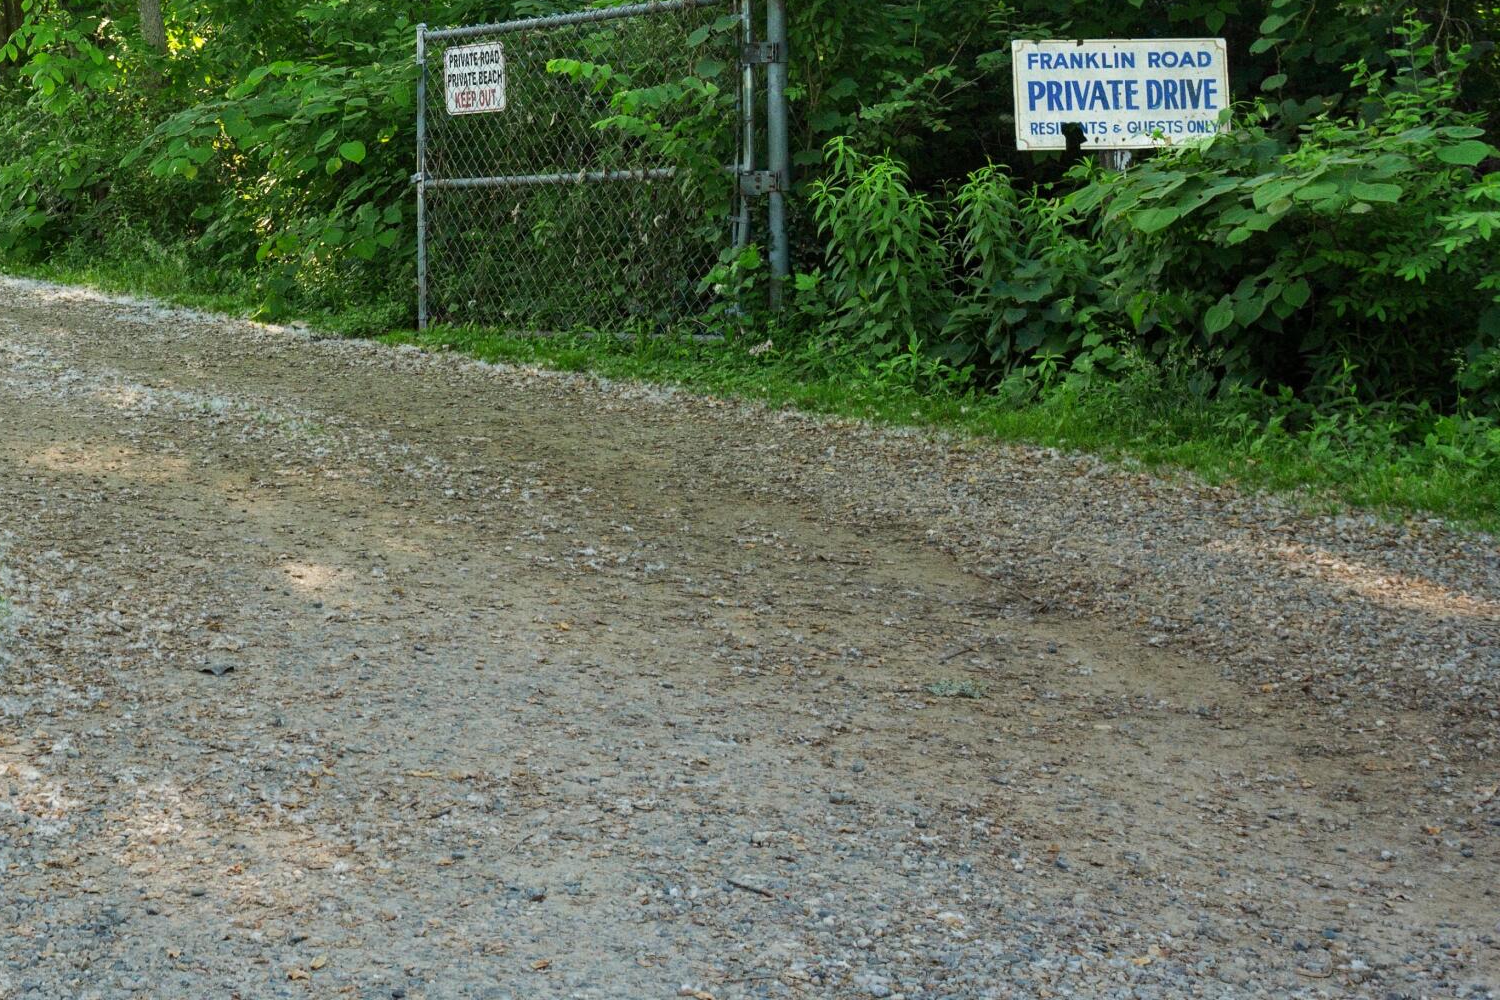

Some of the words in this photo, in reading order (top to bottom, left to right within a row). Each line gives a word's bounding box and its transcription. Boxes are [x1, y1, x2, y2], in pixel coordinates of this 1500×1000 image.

[449, 52, 478, 67] PRIVATE
[481, 50, 499, 65] ROAD
[1028, 52, 1135, 70] FRANKLIN
[1148, 51, 1211, 68] ROAD
[448, 72, 476, 87] PRIVATE
[479, 70, 502, 85] BEACH
[455, 91, 476, 108] KEEP
[479, 89, 496, 106] OUT
[1028, 80, 1140, 111] PRIVATE
[1146, 79, 1217, 110] DRIVE
[1114, 124, 1121, 133] &
[1127, 120, 1183, 133] GUESTS
[1188, 120, 1218, 133] ONLY
